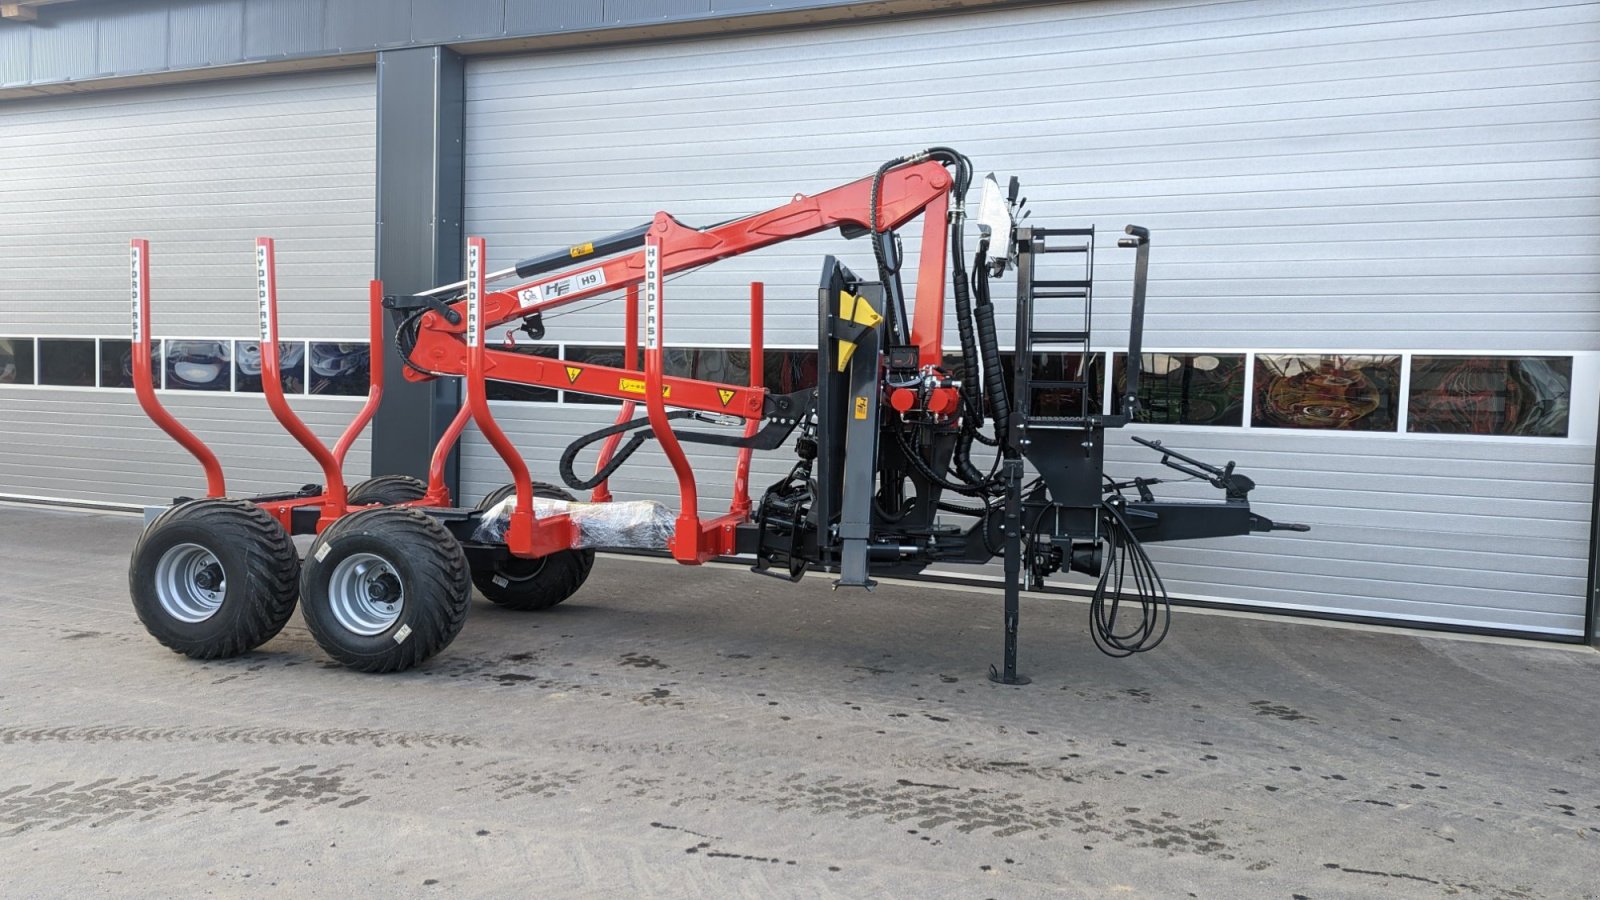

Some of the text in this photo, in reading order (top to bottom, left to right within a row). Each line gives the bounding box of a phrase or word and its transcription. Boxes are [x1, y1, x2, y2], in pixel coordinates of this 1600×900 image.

[131, 249, 139, 340] HYDROFAST
[257, 249, 267, 339] HYDROFAST
[468, 249, 476, 344] HYDROFAST
[581, 274, 597, 285] H9
[647, 248, 656, 346] HYDROFAST
